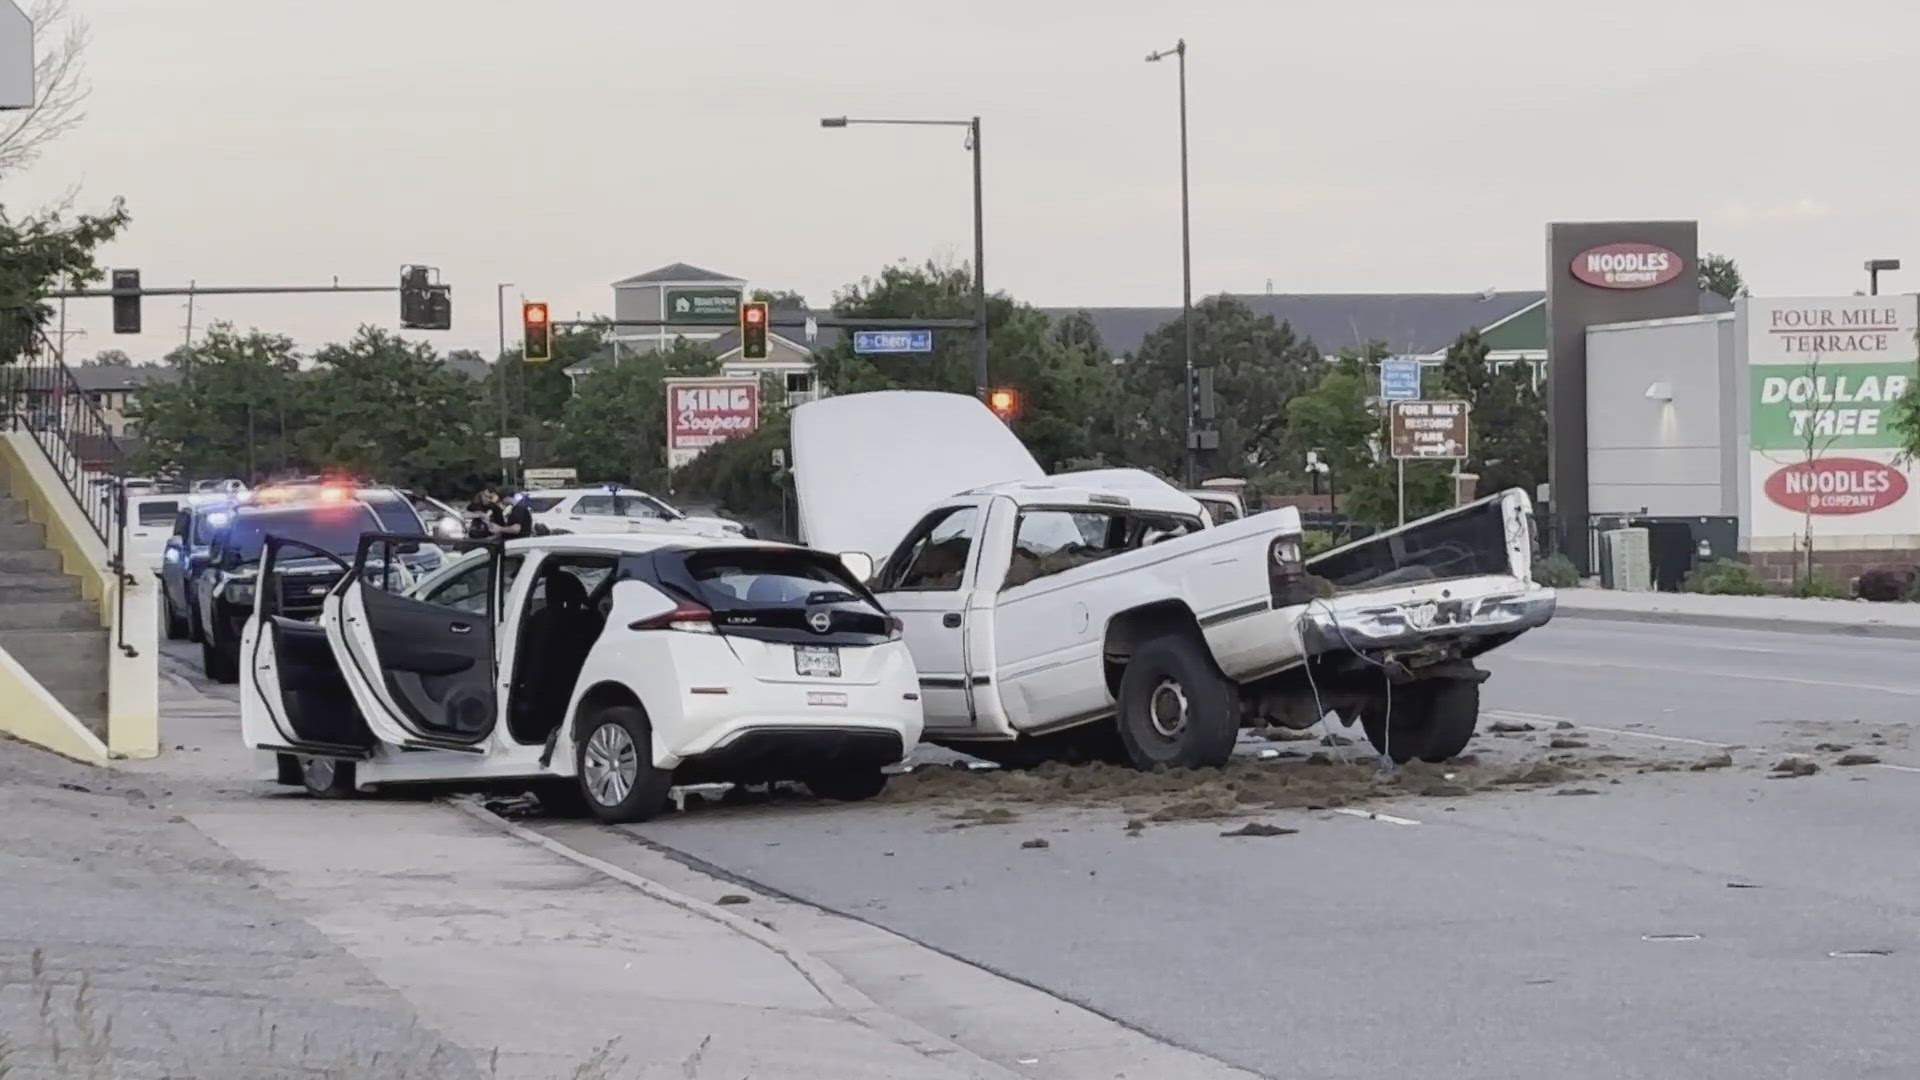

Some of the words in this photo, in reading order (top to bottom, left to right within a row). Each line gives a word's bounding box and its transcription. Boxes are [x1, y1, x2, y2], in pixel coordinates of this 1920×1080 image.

[1587, 253, 1669, 272] NOODLES
[1771, 309, 1834, 327] FOUR
[1841, 308, 1897, 326] MILE
[874, 335, 912, 350] Cherry
[1781, 334, 1888, 353] TERRACE
[677, 388, 750, 411] KING
[1760, 375, 1909, 404] DOLLAR
[676, 410, 752, 436] Soopers
[1788, 408, 1882, 436] TREE
[1785, 470, 1890, 494] NOODLES
[1821, 494, 1876, 507] COMPANY
